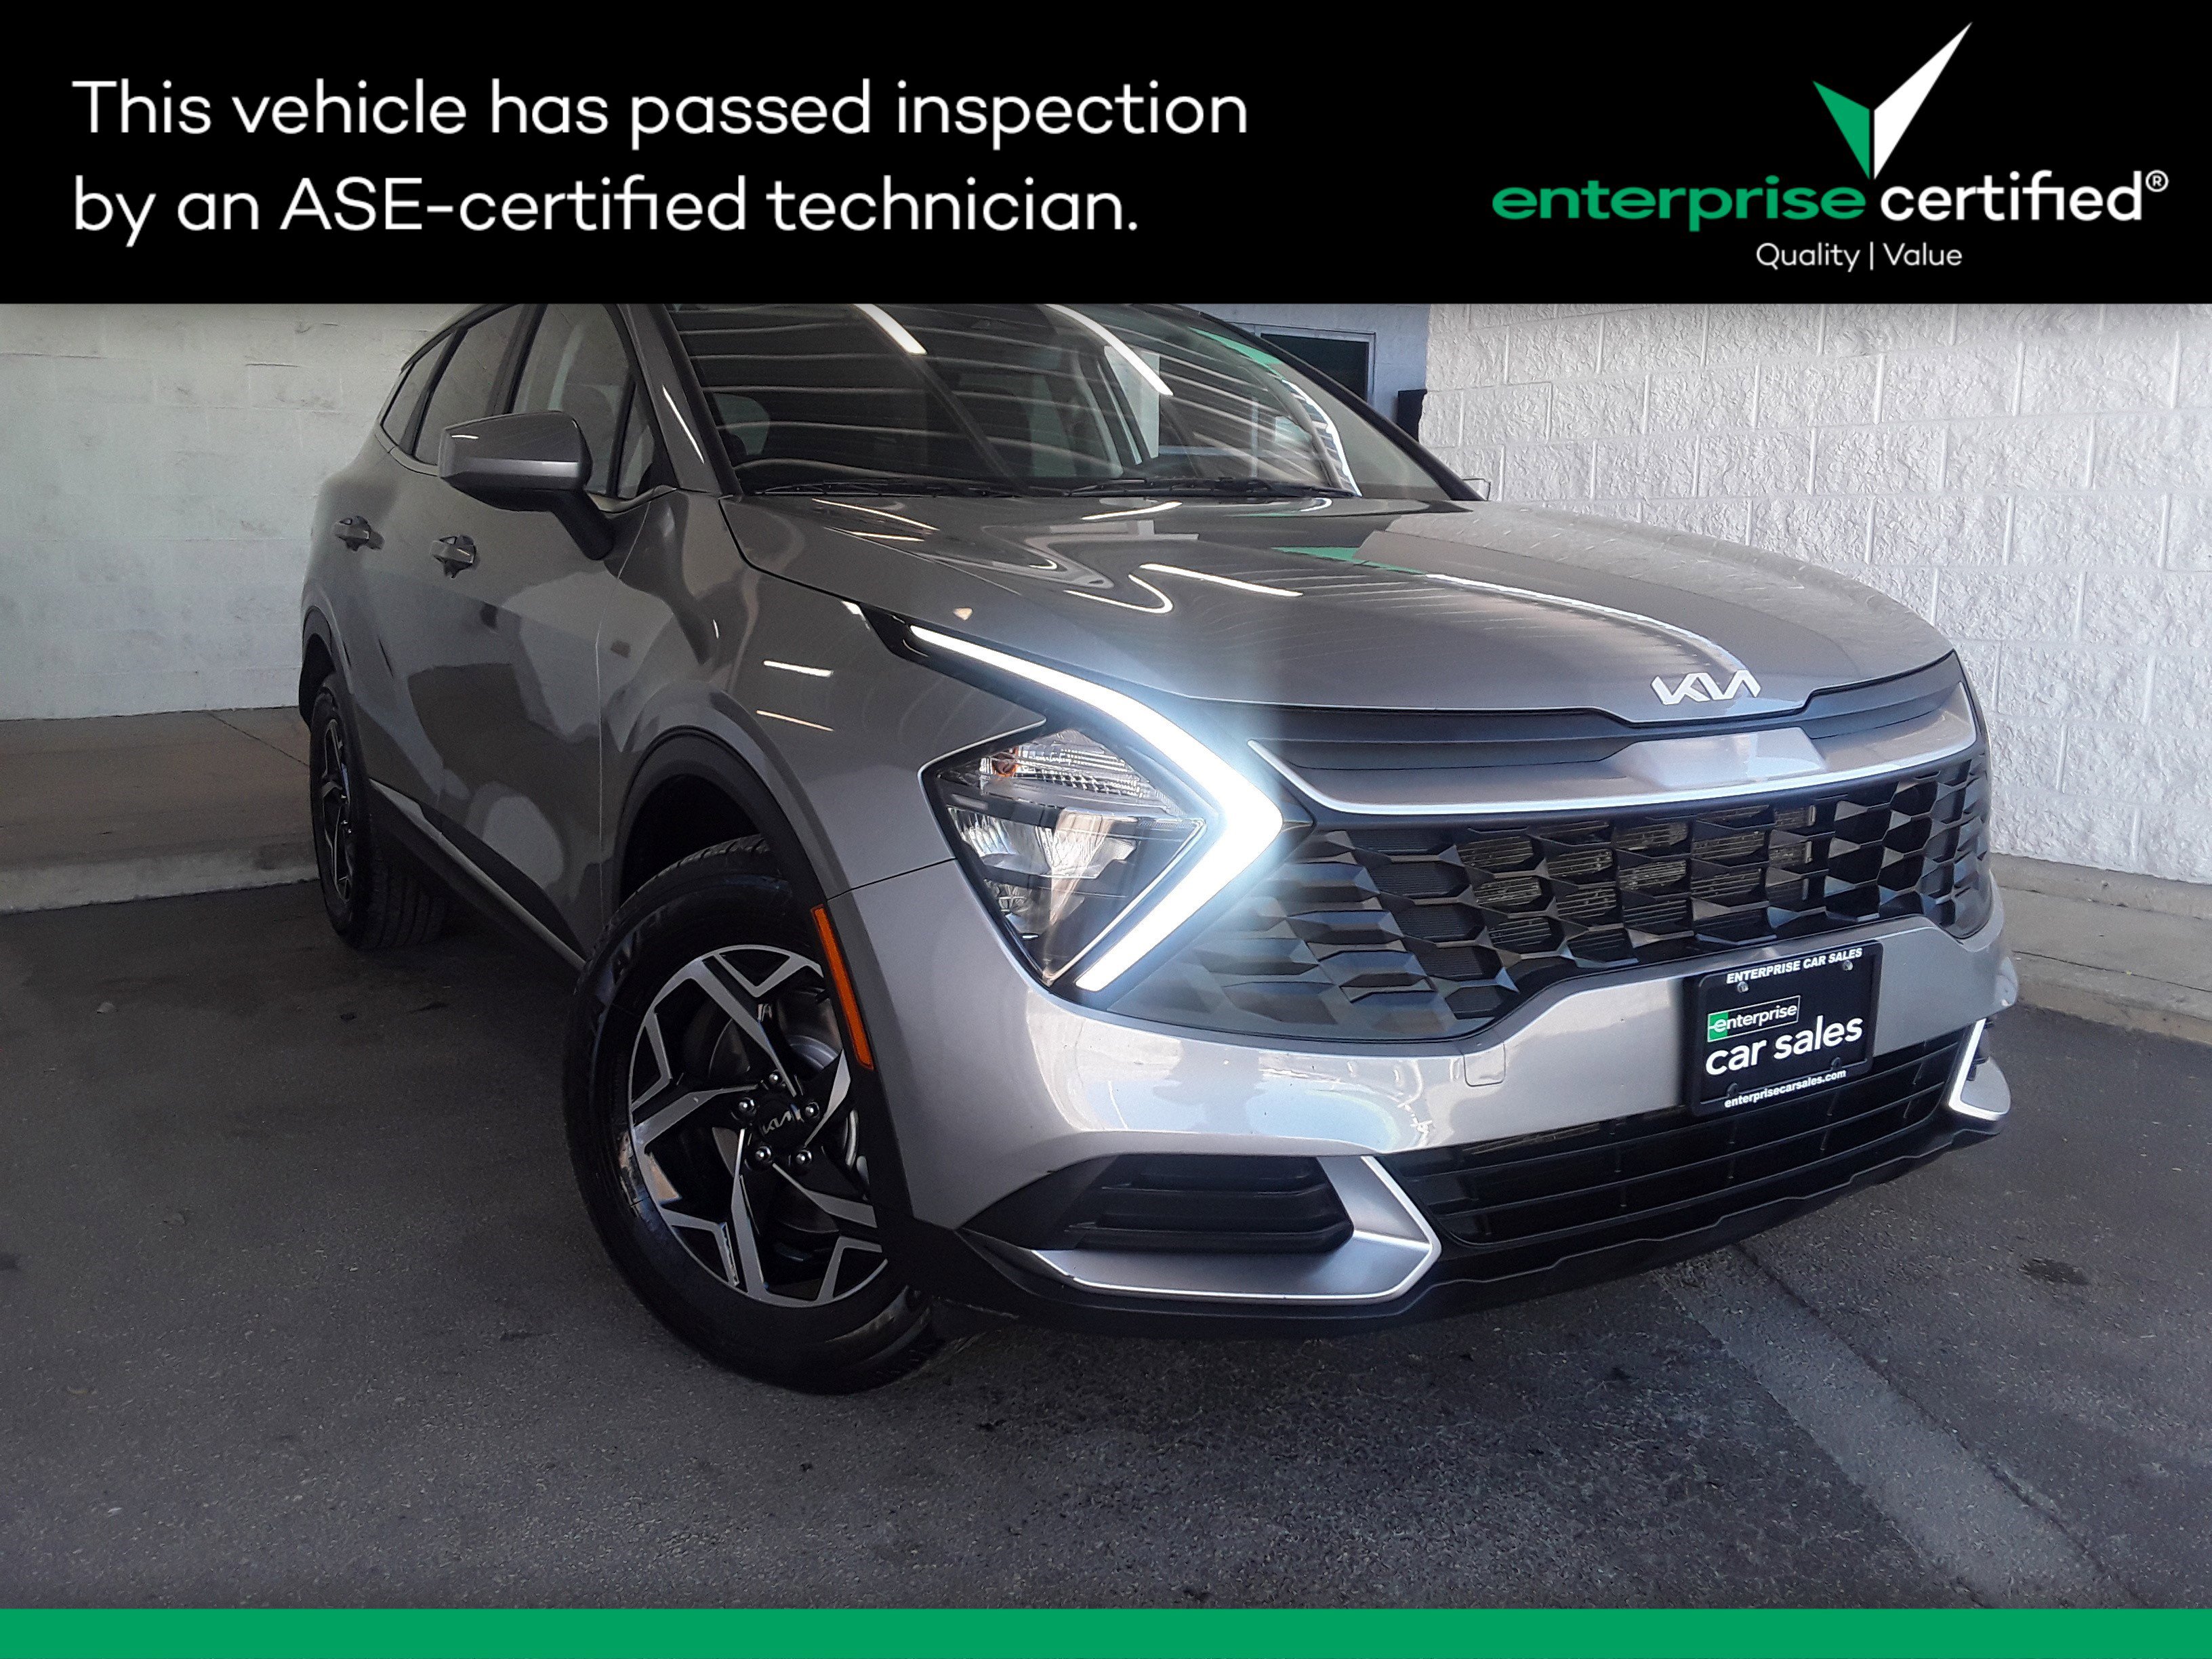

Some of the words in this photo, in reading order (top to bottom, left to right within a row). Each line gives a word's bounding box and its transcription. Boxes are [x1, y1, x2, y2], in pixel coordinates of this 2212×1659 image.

[1726, 960, 1801, 984] ENTERPRISE
[1803, 954, 1826, 969] CAR
[1828, 947, 1862, 964] SALES
[1713, 1004, 1797, 1033] enterprise
[1705, 1039, 1767, 1076] car
[1773, 1015, 1863, 1060] sales
[1724, 1069, 1847, 1108] enterprisecarsales.com
